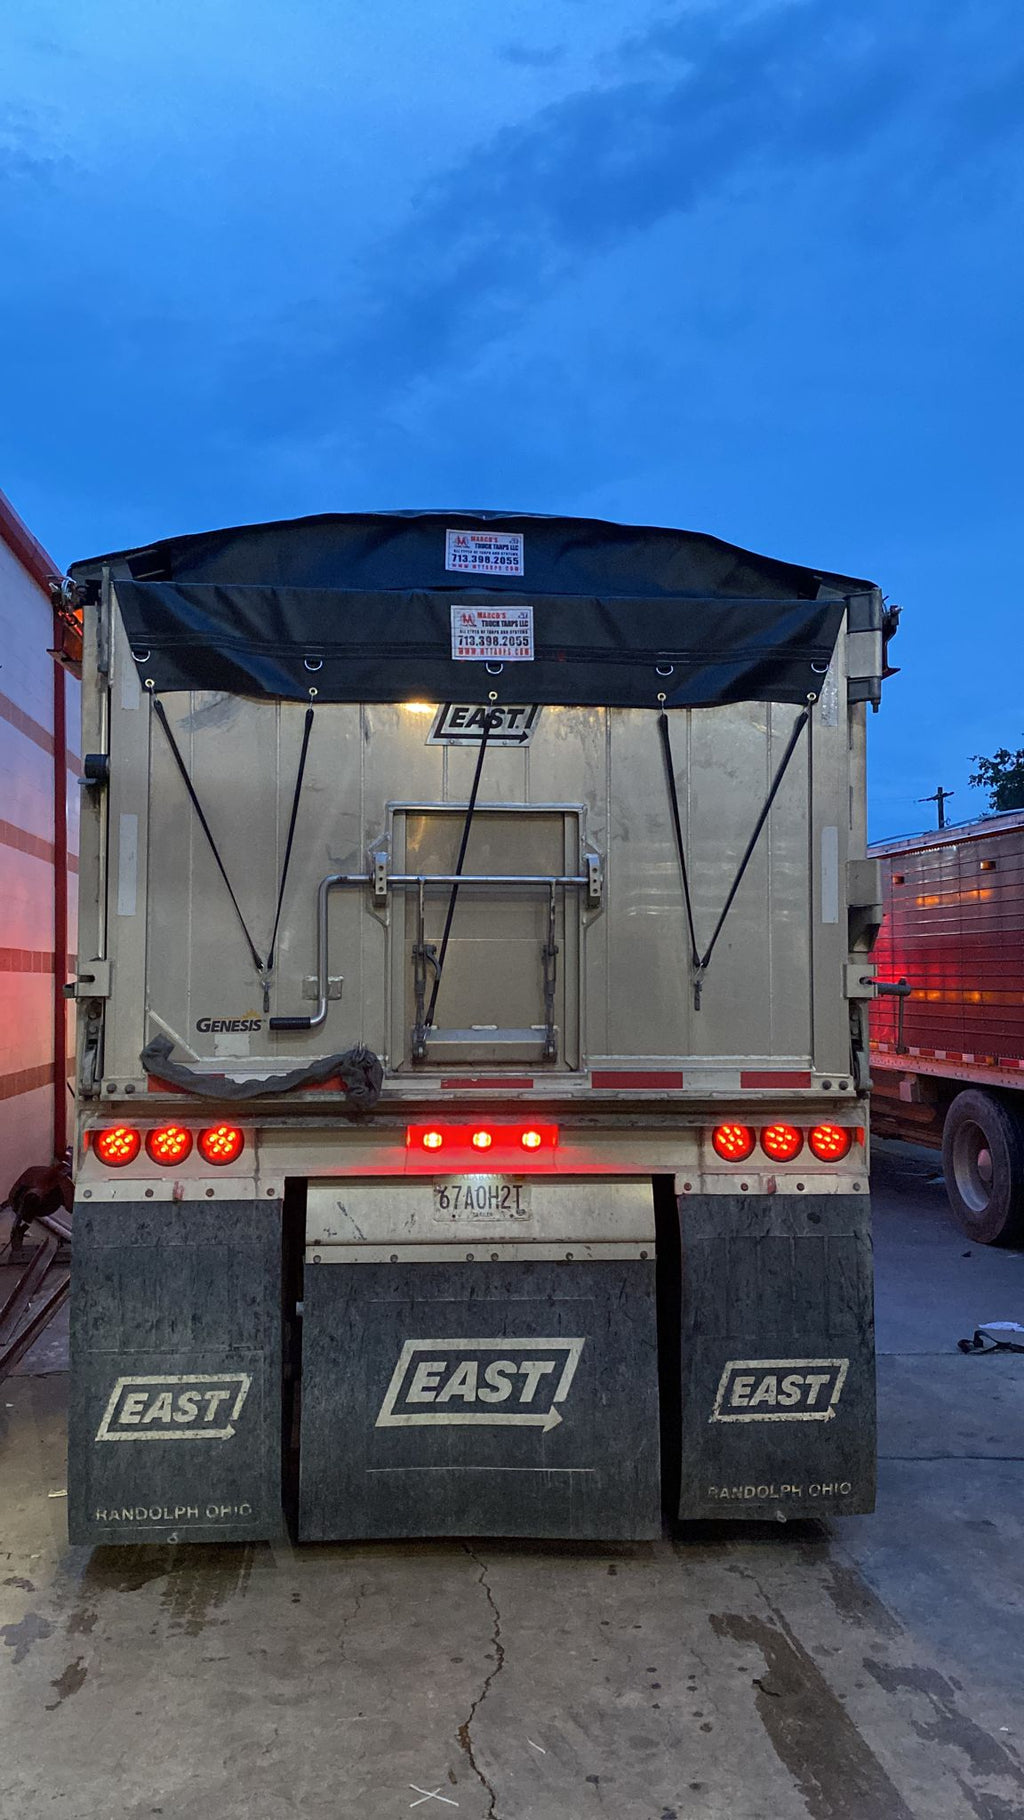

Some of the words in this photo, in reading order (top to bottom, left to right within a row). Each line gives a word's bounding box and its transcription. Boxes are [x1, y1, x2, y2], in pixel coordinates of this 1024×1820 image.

[474, 542, 492, 550] TRUCK
[451, 553, 519, 565] 713.398.2055
[477, 611, 506, 619] MARCO'S
[458, 636, 529, 647] 713.398.2055
[196, 1017, 262, 1033] GENESIS
[404, 1360, 556, 1403] EAST
[730, 1374, 831, 1407] EAST
[118, 1390, 231, 1424] EAST
[708, 1484, 802, 1500] RANDOLPH
[808, 1482, 852, 1497] OHIO
[96, 1505, 199, 1521] RANDOLPH
[206, 1503, 252, 1519] OHIO
